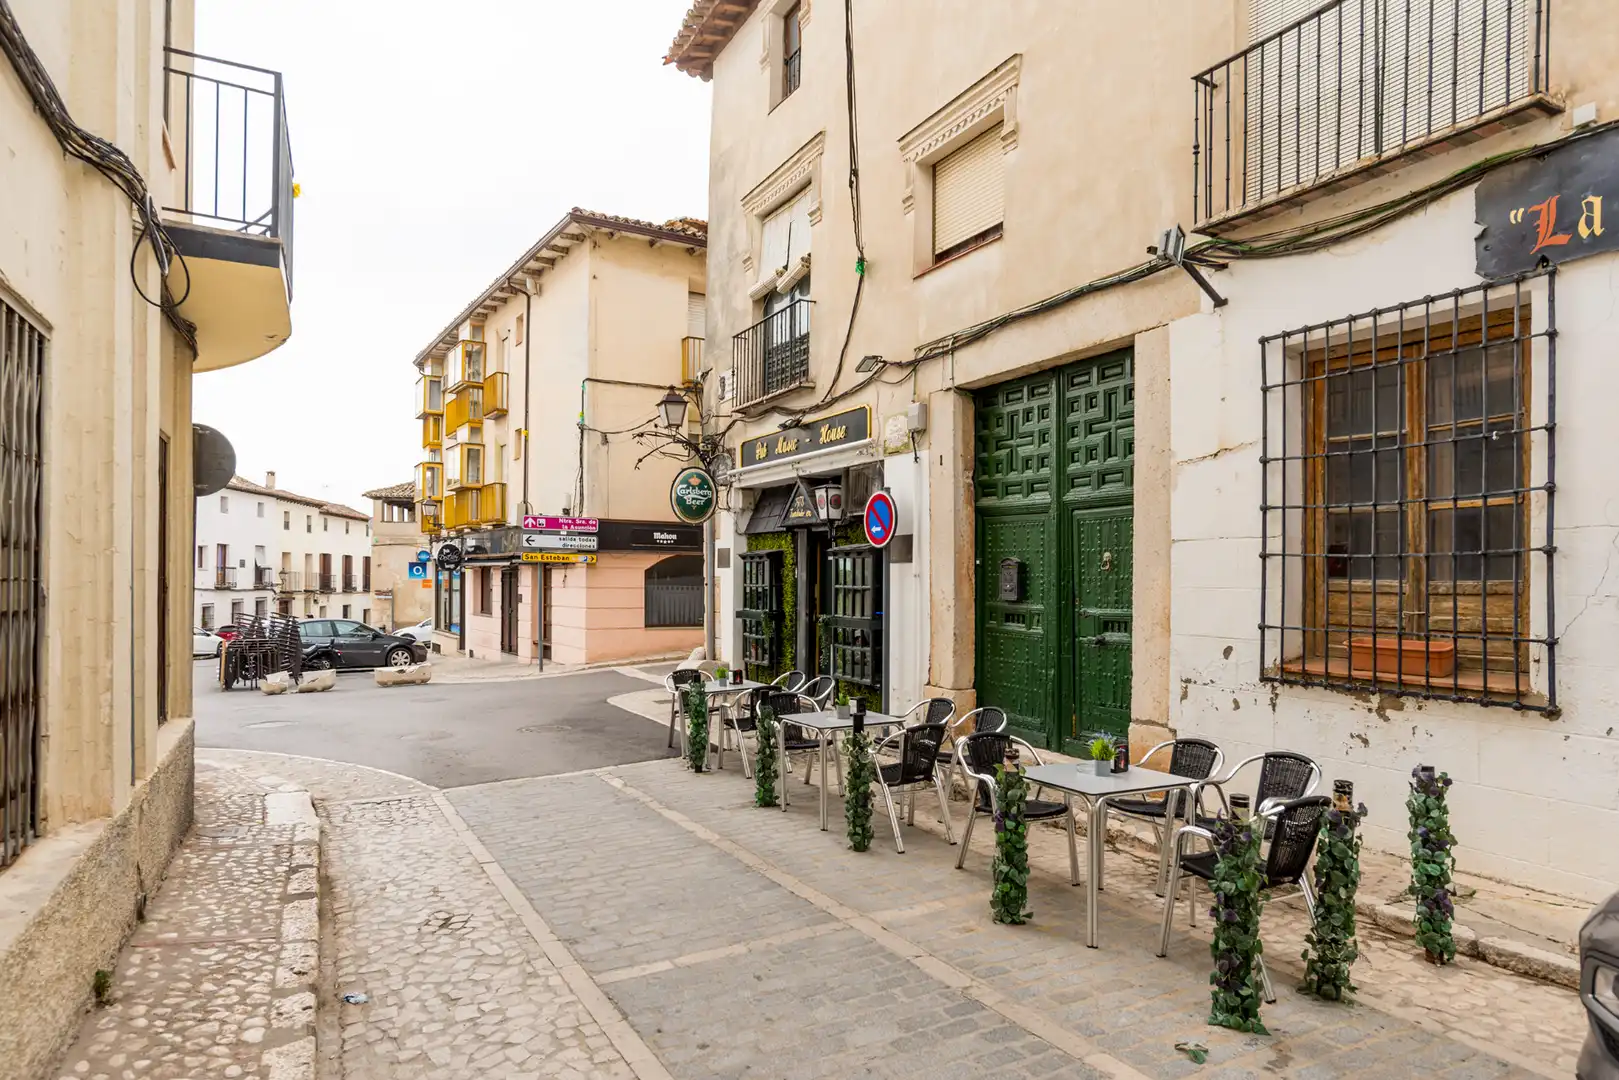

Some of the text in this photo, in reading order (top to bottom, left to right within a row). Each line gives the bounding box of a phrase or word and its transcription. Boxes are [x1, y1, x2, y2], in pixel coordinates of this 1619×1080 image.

[819, 423, 847, 445] House
[676, 484, 712, 498] Carlsberg
[685, 497, 706, 506] Beer
[653, 532, 677, 540] Mahou
